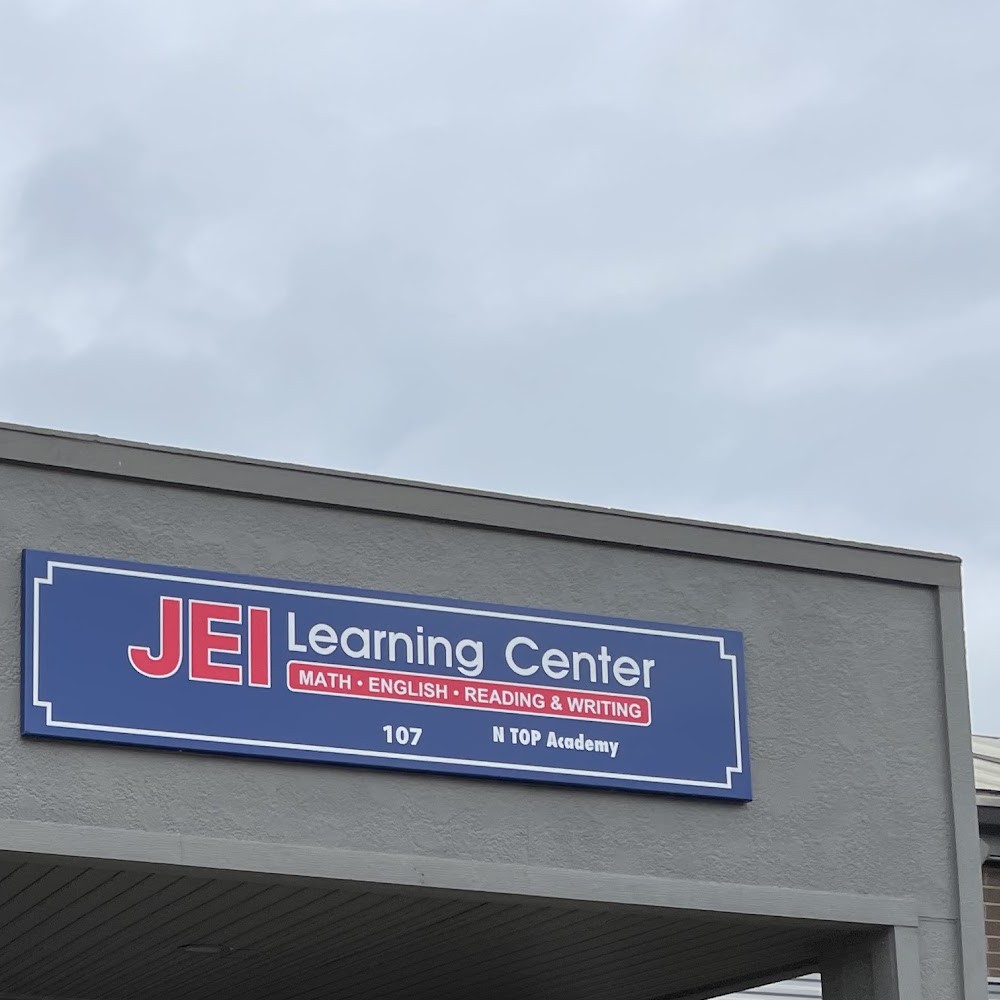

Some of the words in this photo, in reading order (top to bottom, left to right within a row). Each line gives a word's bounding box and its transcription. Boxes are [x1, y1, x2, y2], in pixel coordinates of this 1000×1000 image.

[127, 595, 271, 688] JEI
[287, 611, 484, 677] Learning
[504, 635, 655, 688] Center
[298, 669, 352, 690] MATH
[368, 677, 448, 700] ENGLISH
[464, 687, 546, 709] READING
[549, 695, 563, 711] &
[567, 697, 642, 719] WRITING
[382, 725, 422, 746] 107
[492, 726, 504, 743] N
[509, 727, 541, 747] TOP
[546, 731, 619, 757] Academy
